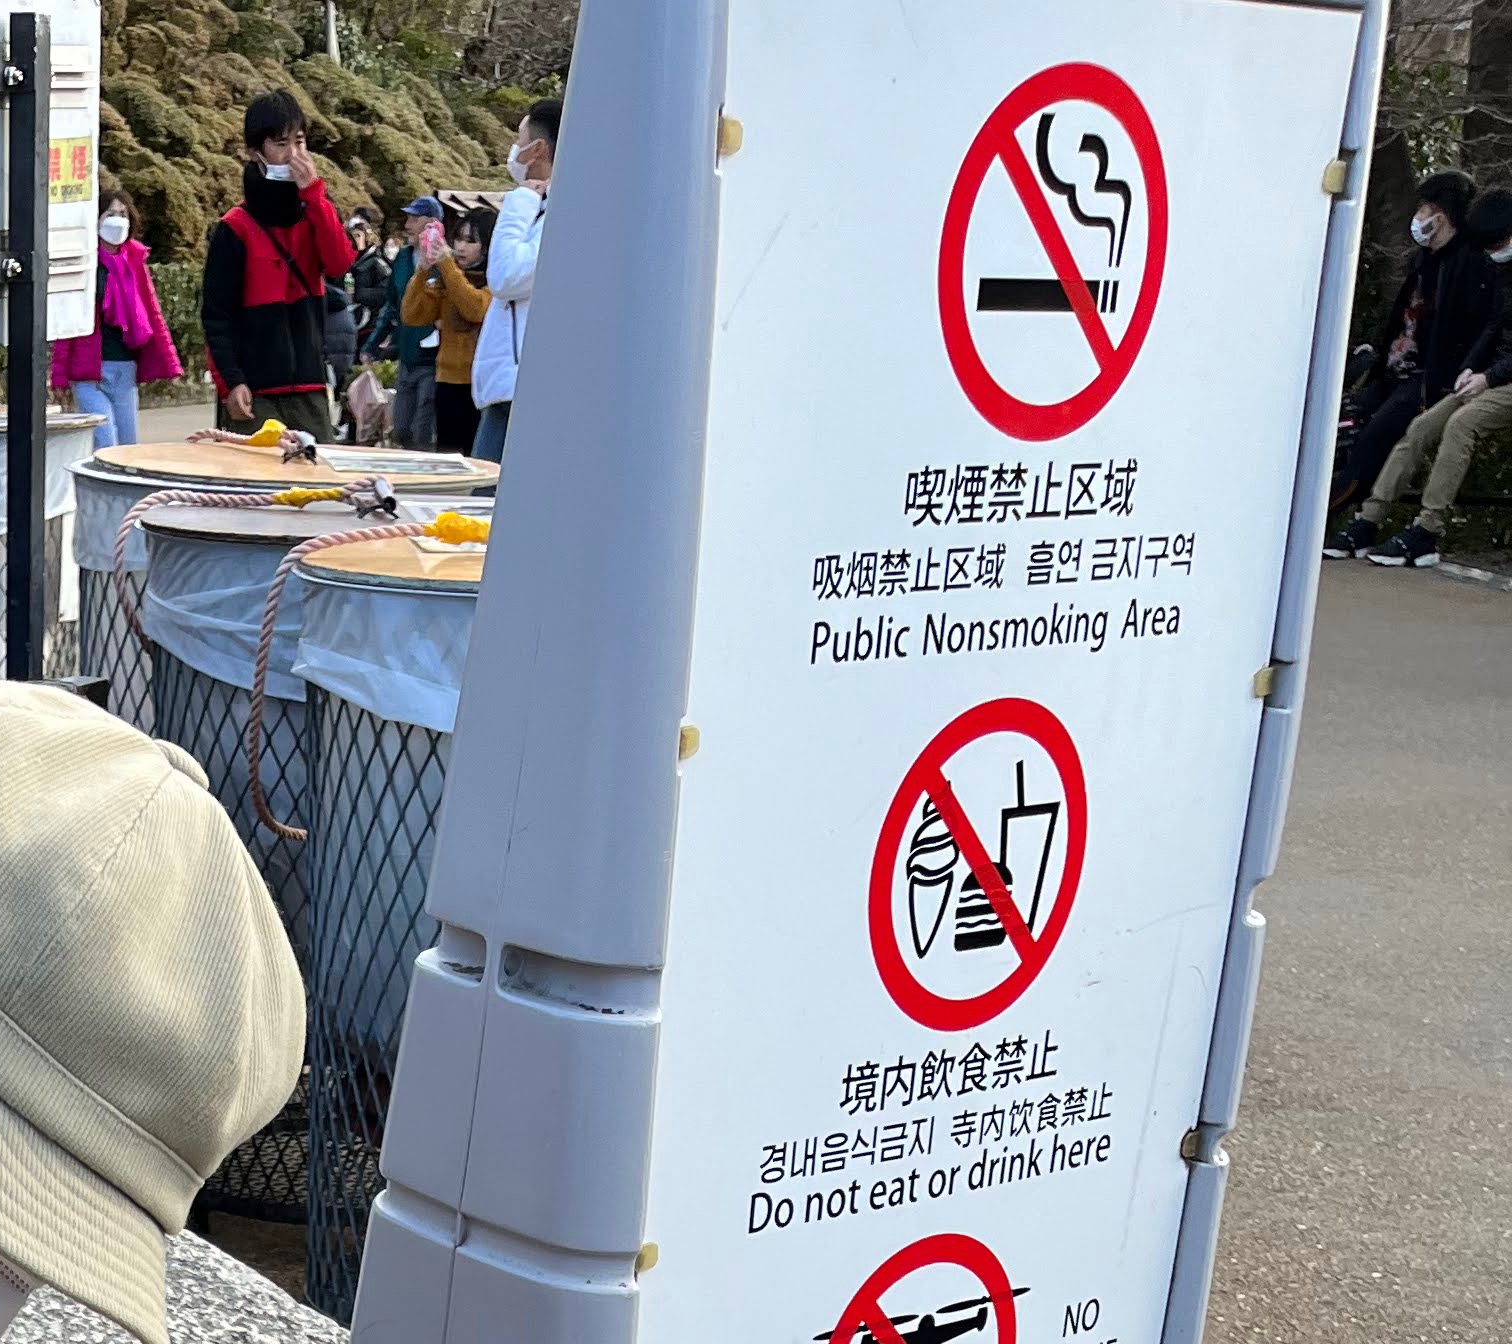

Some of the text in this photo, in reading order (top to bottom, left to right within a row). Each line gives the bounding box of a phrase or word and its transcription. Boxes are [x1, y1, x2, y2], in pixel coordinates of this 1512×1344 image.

[903, 458, 1138, 527] 喫煙禁止区域
[812, 532, 1196, 601] 吸烟禁止区域 흡연 금지구역
[810, 598, 1181, 665] Public Nonsmoking Area
[839, 1029, 1059, 1116] 境内飲食禁止
[759, 1081, 1113, 1184] 경내음식금지 寺内饮食禁止
[747, 1130, 1112, 1234] Do not eat or drink here
[1063, 1298, 1100, 1338] NO
